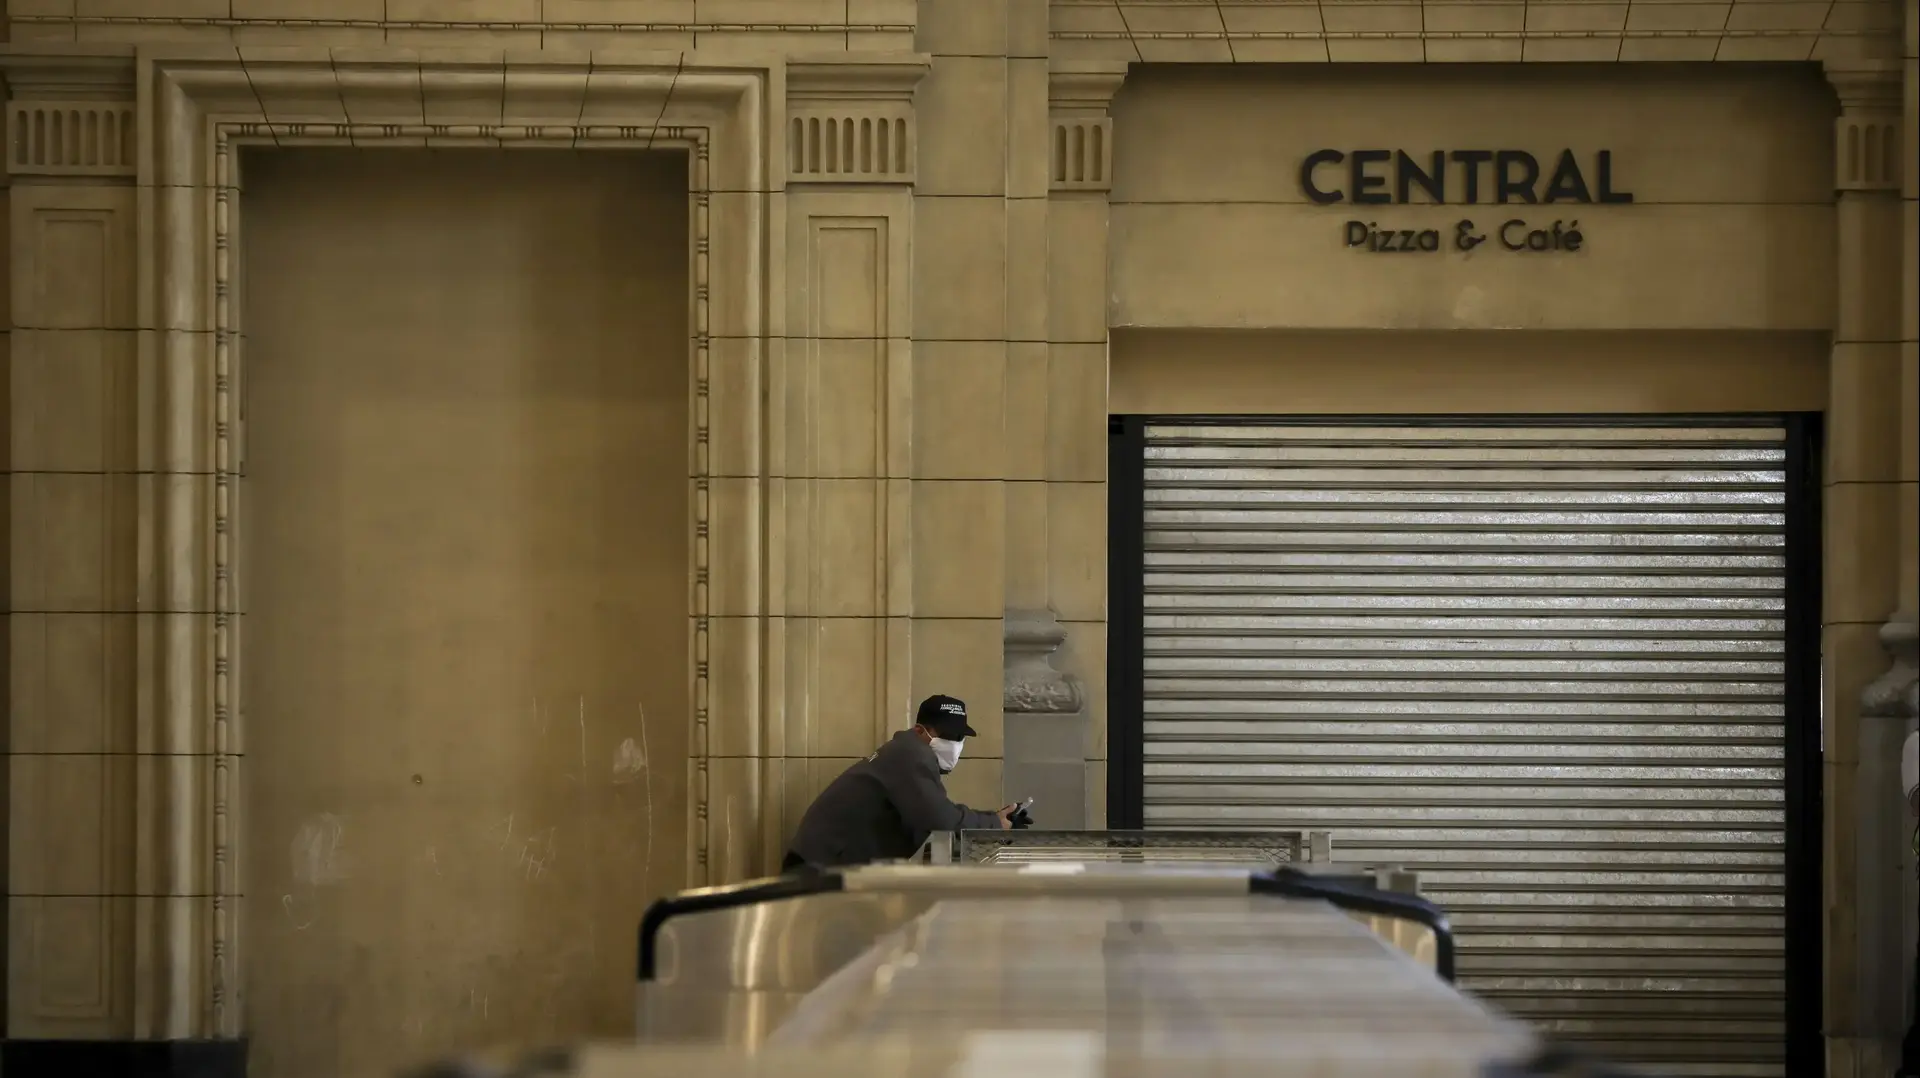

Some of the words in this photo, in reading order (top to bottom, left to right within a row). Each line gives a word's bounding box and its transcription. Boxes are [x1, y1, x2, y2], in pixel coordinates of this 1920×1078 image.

[1300, 148, 1633, 204] CENTRAL
[1346, 220, 1440, 252] Pizza
[1455, 219, 1486, 251] &
[1499, 219, 1584, 252] Café
